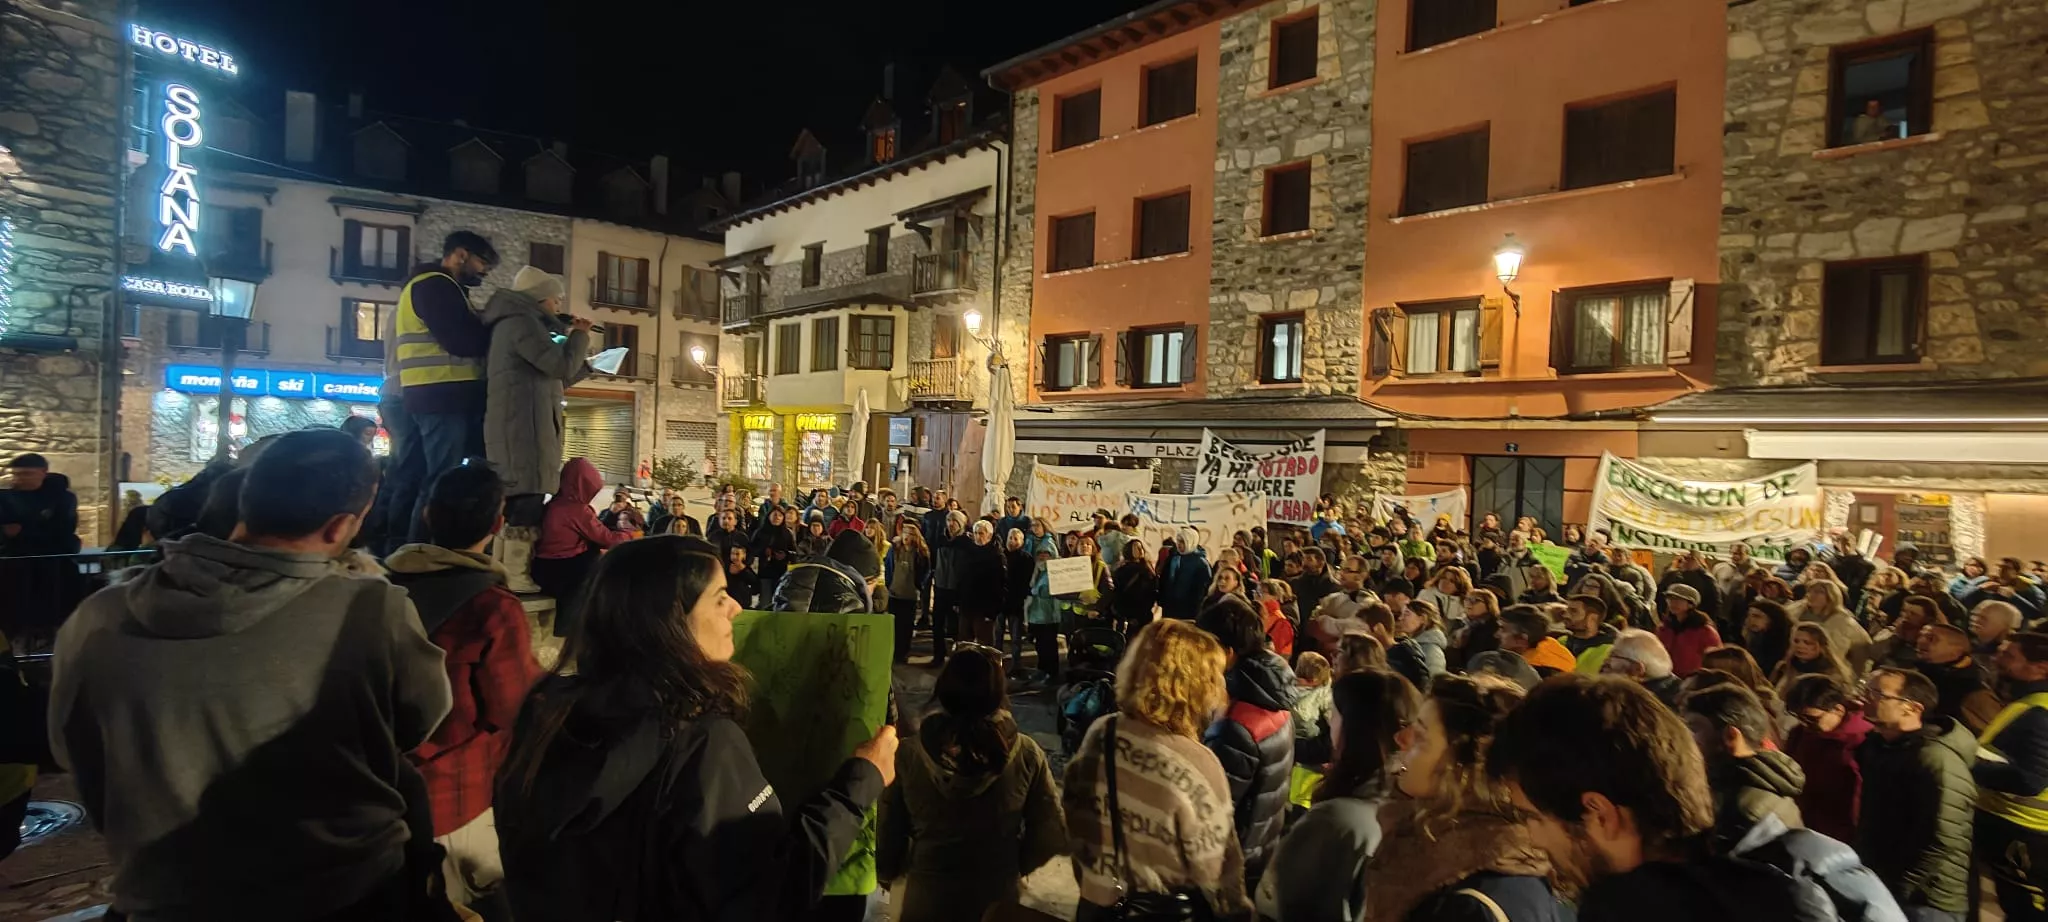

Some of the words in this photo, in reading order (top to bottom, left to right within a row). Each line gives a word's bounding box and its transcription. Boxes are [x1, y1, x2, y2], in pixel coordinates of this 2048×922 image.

[130, 24, 238, 75] HOTEL
[159, 83, 202, 256] SOLANA
[166, 281, 213, 301] ROLD
[180, 374, 258, 389] monña
[278, 379, 304, 392] ski
[1096, 445, 1135, 455] BAR
[1201, 453, 1222, 476] YA
[1086, 479, 1103, 491] HA
[1232, 479, 1295, 497] QUIERE
[1763, 473, 1799, 499] DE
[1266, 499, 1318, 521] UCHAD
